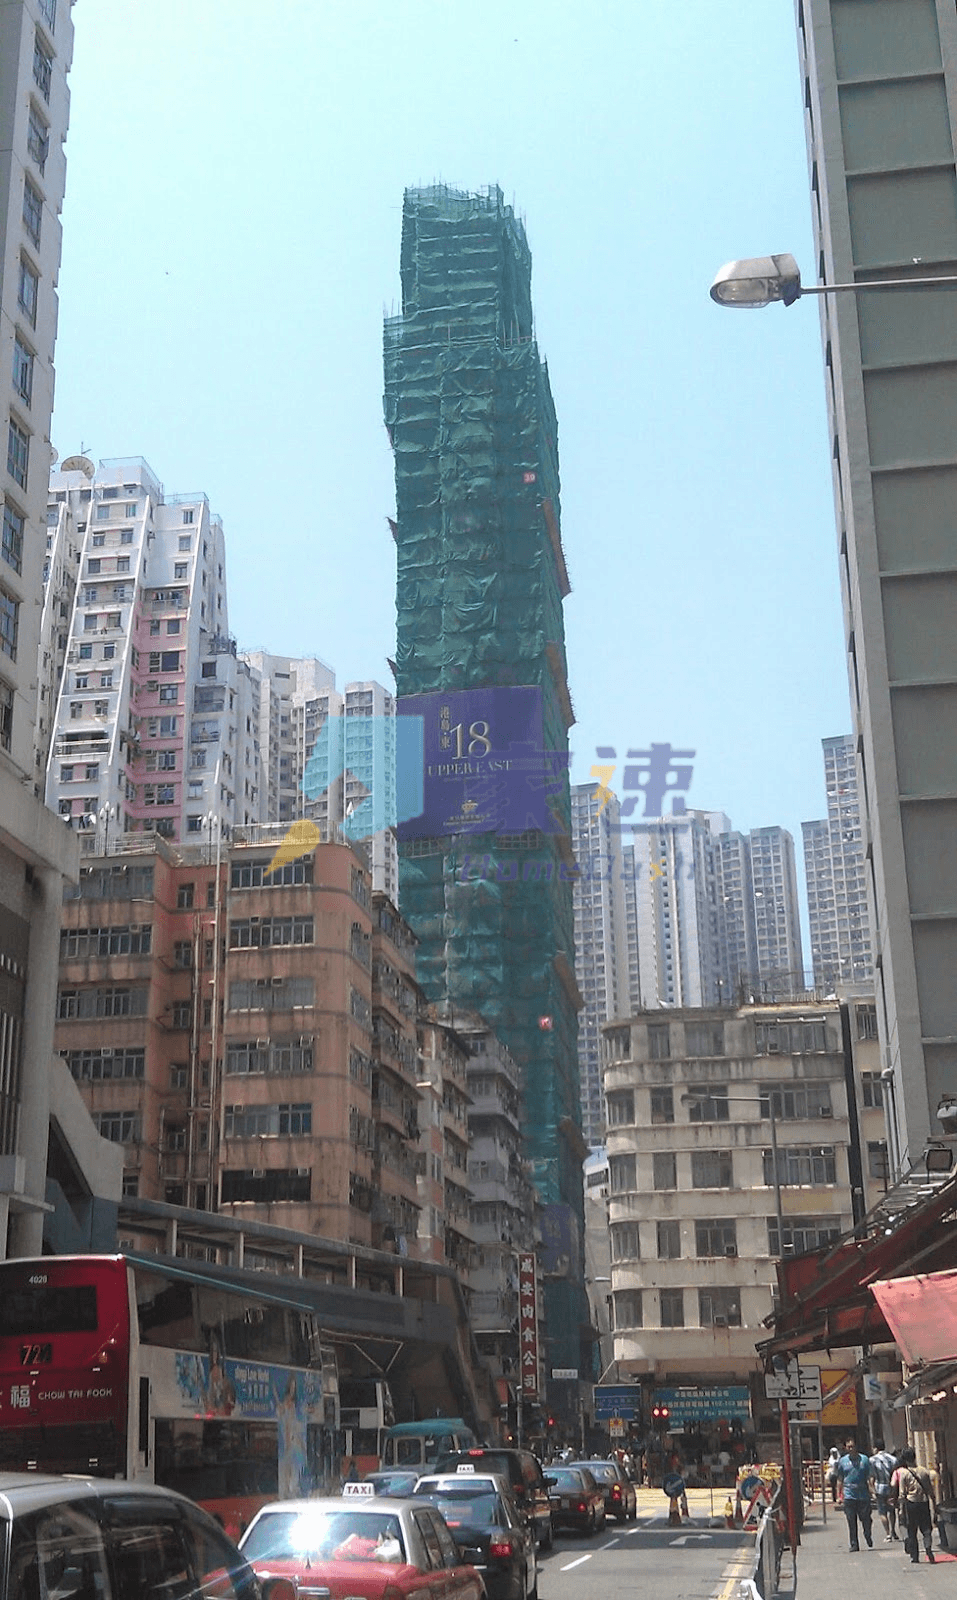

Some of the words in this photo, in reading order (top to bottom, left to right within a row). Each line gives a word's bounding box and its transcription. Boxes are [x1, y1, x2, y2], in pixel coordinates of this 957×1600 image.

[449, 720, 492, 760] 18
[427, 762, 473, 776] UPPER
[475, 760, 513, 773] EAST
[38, 1389, 66, 1401] CHOW
[68, 1389, 83, 1399] TAI
[86, 1387, 113, 1398] FOOK
[346, 1486, 372, 1495] TAXI
